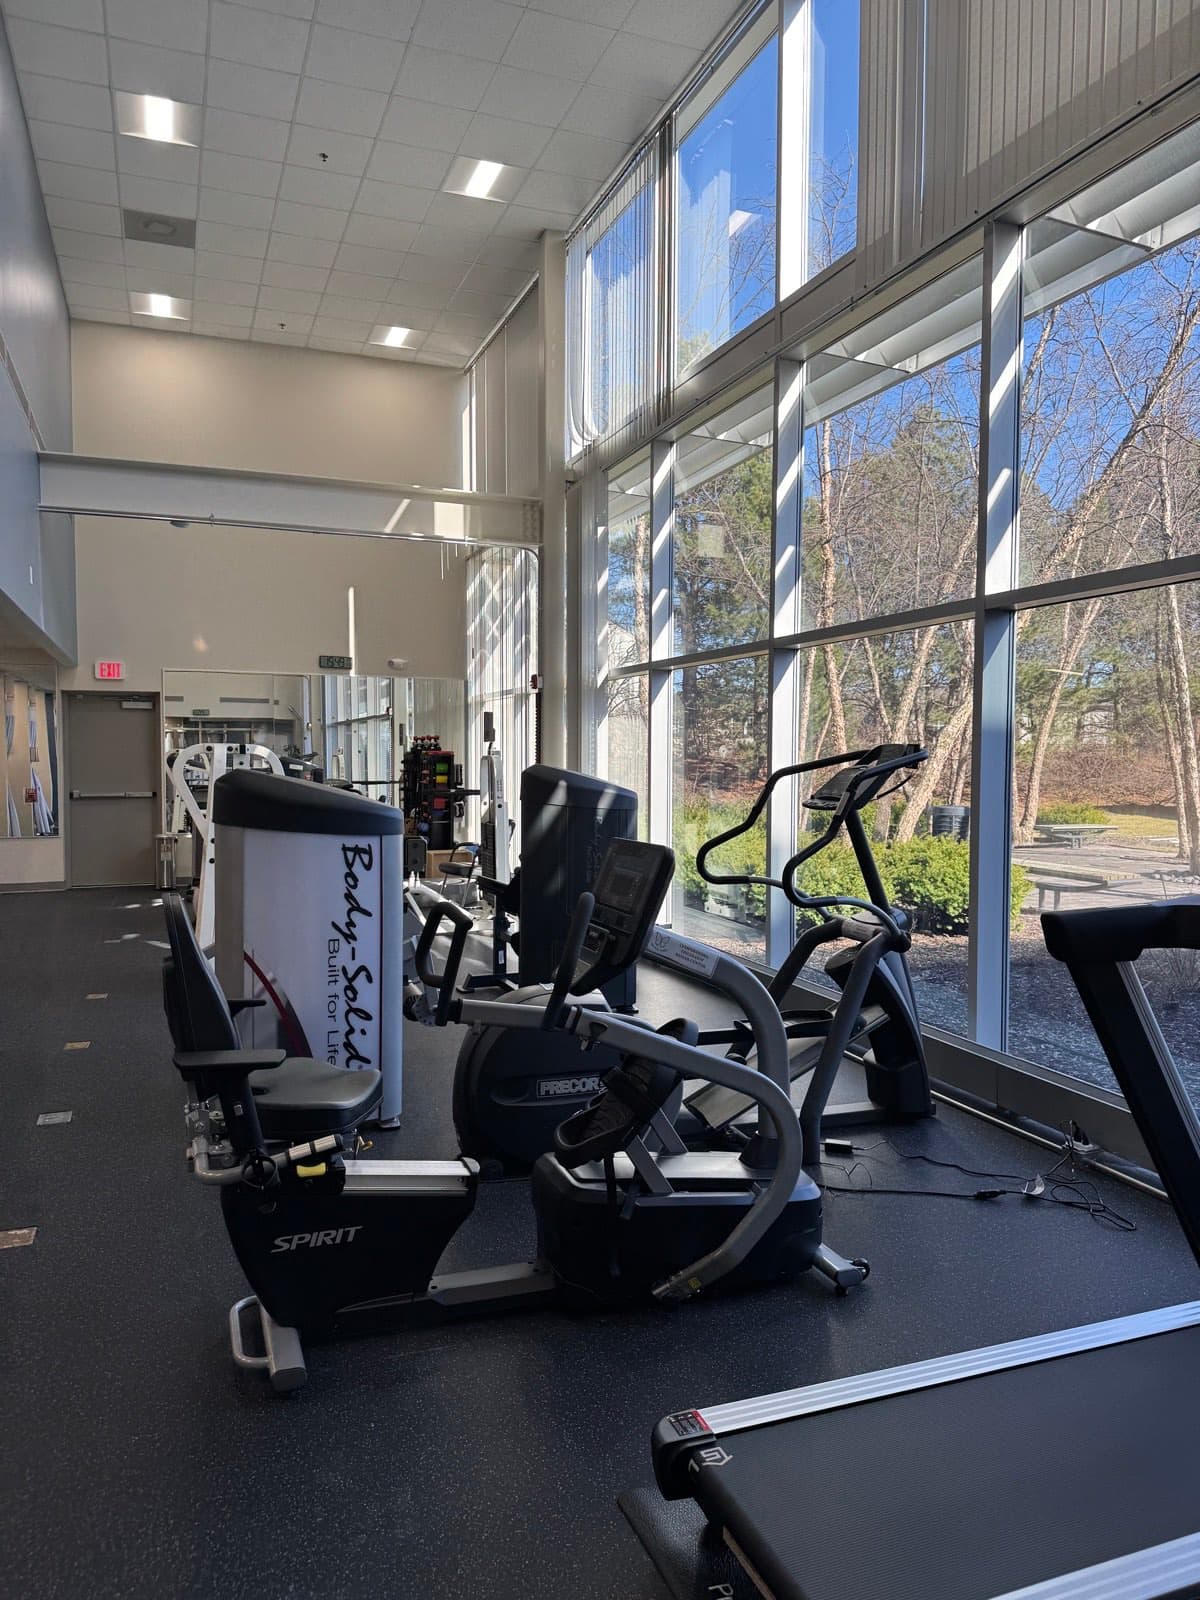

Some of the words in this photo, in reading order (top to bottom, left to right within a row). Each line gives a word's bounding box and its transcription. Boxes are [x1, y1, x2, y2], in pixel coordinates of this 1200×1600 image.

[100, 662, 121, 678] EXIT
[328, 938, 340, 986] Built
[331, 843, 373, 1069] Body-Solid
[328, 993, 340, 1022] for
[328, 1030, 340, 1066] Life
[540, 1077, 600, 1095] PRECOR
[271, 1226, 363, 1253] SPIRIT
